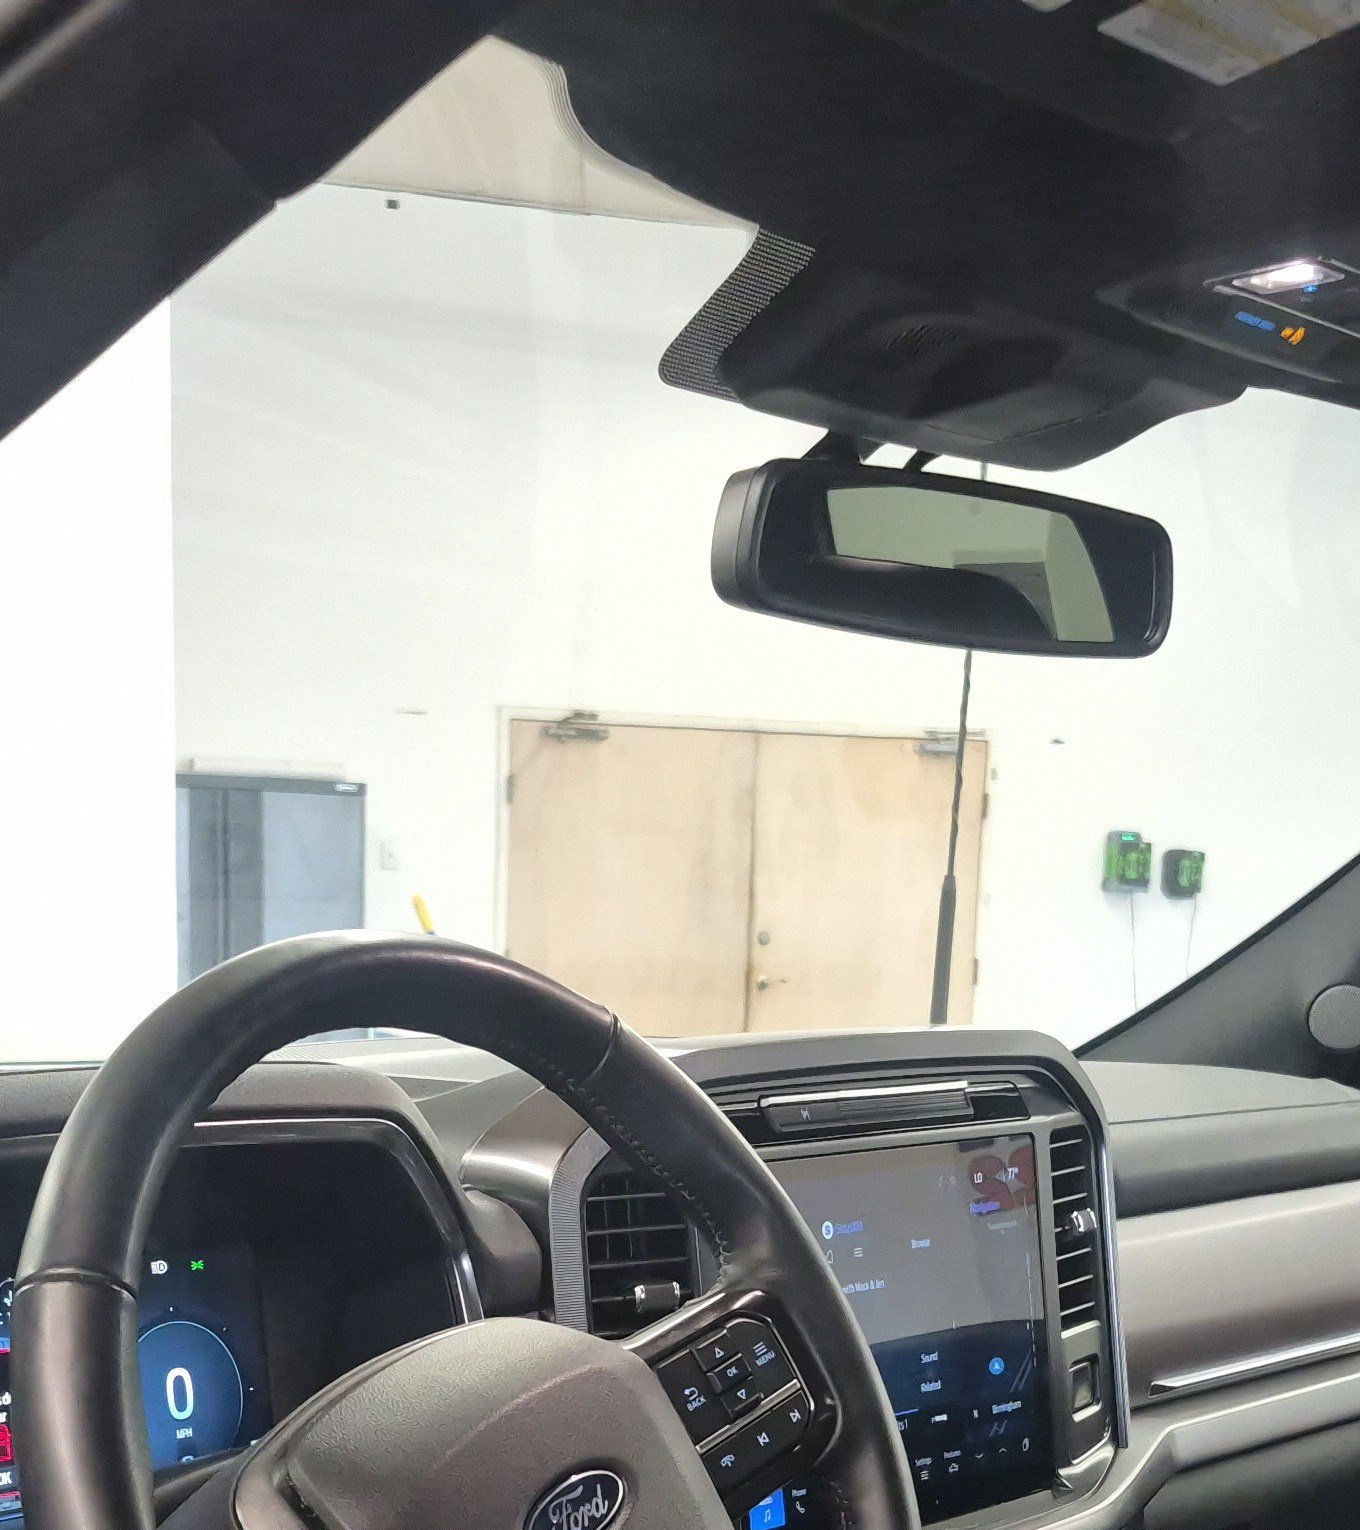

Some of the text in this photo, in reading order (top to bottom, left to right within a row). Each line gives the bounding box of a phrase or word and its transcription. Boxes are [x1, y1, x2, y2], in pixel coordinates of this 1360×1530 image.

[755, 1350, 776, 1367] MENU
[726, 1366, 739, 1378] OK
[166, 1367, 194, 1420] 0
[686, 1395, 707, 1412] BACK
[176, 1427, 193, 1439] MPH
